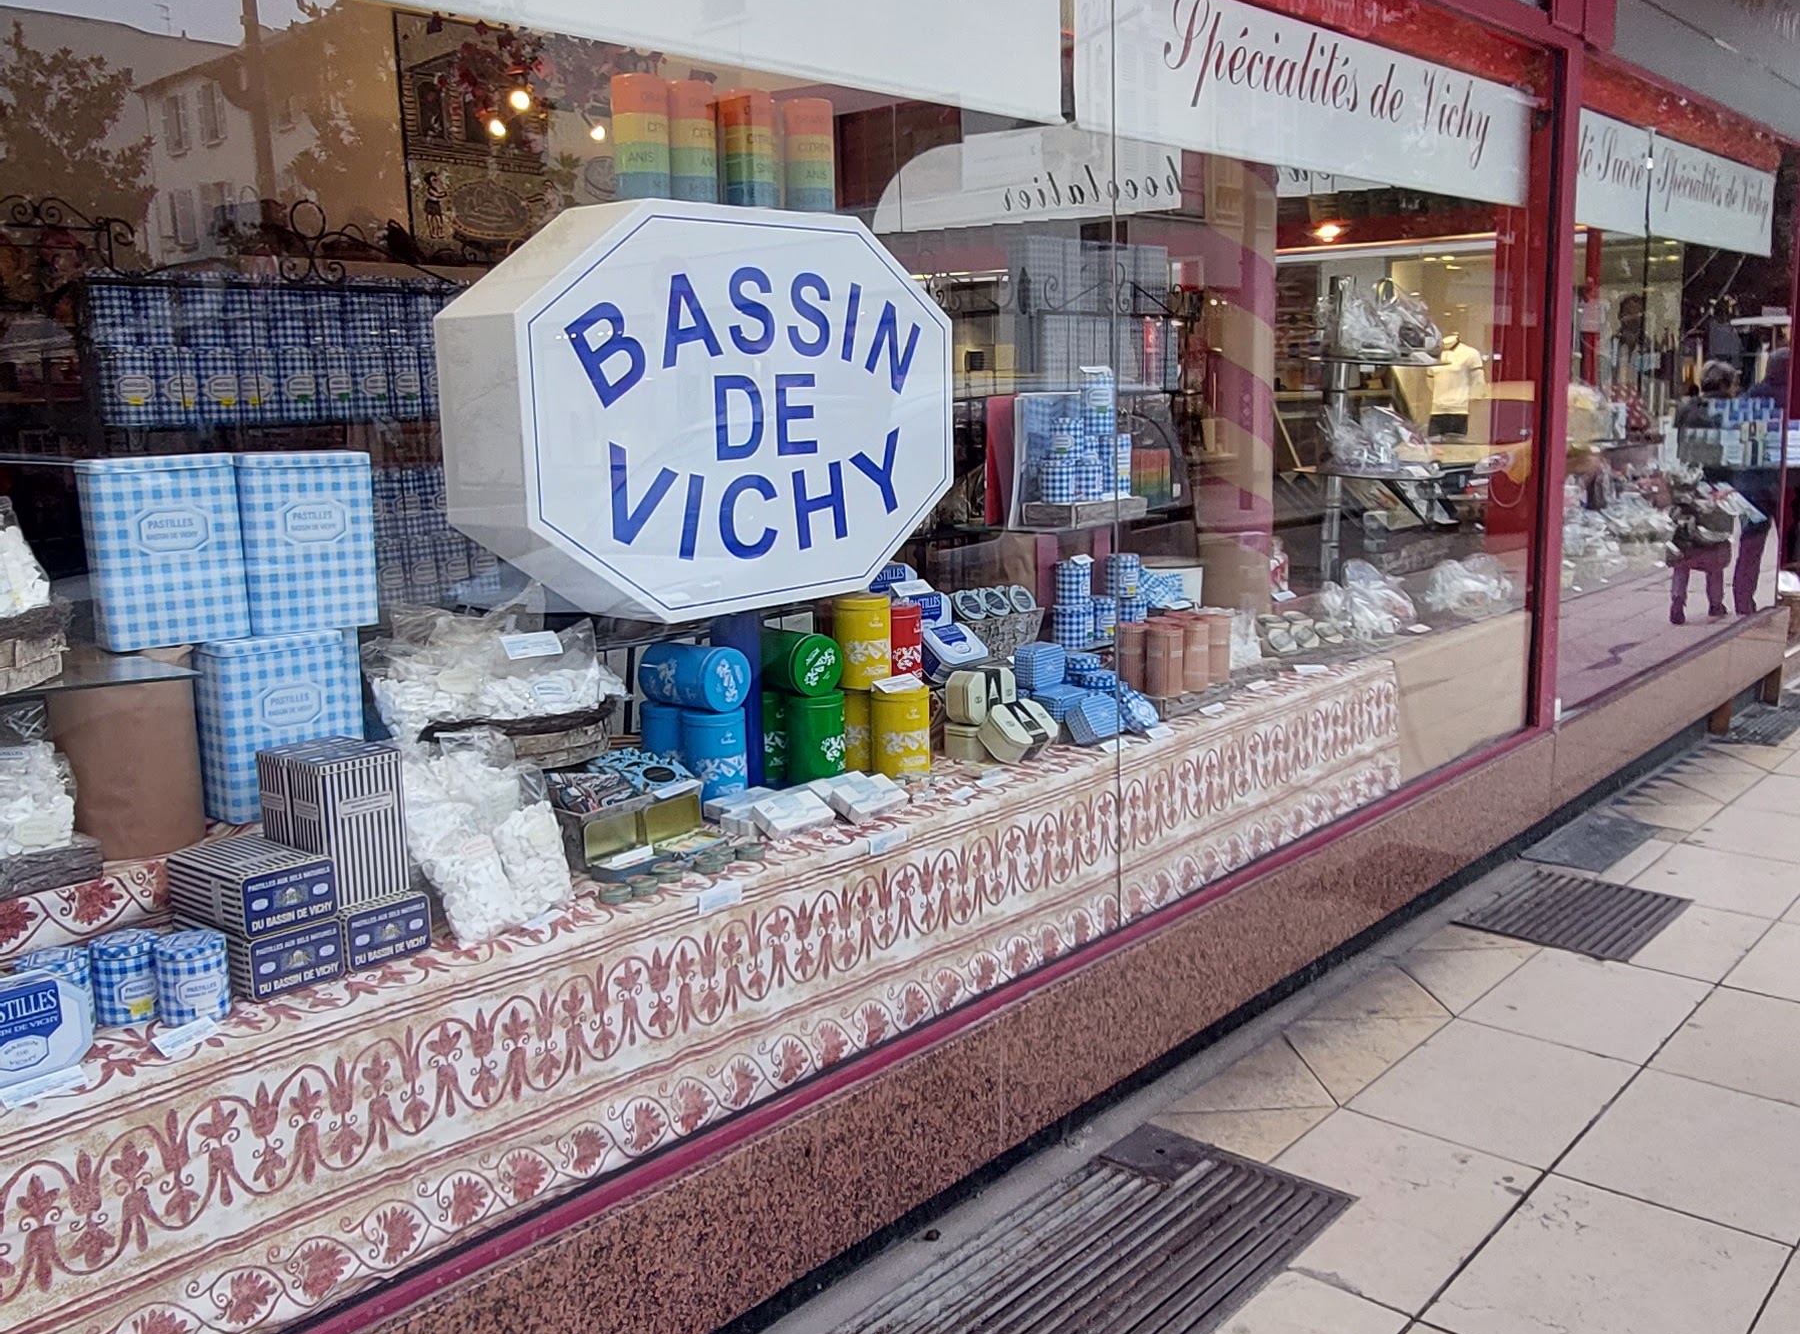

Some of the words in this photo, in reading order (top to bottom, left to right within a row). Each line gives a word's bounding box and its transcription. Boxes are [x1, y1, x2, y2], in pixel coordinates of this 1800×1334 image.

[1369, 70, 1405, 123] de
[1423, 67, 1493, 170] Vichy
[1597, 125, 1646, 191] Sucré
[563, 265, 922, 410] BASSIN
[712, 372, 819, 463] DE
[608, 425, 901, 562] VICHY
[147, 517, 194, 530] PASTILLES
[292, 510, 333, 521] PASTILLES
[876, 568, 906, 581] STILLES
[251, 918, 265, 932] DU
[265, 910, 296, 928] BASSIN
[296, 907, 309, 920] DE
[308, 900, 334, 916] VICHY
[354, 953, 367, 966] DU
[367, 944, 395, 962] BASSIN
[394, 941, 406, 954] DE
[405, 934, 428, 950] VICHY
[259, 981, 272, 995] DU
[273, 972, 303, 991] BASSIN
[303, 968, 316, 981] DE
[315, 960, 340, 977] VICHY
